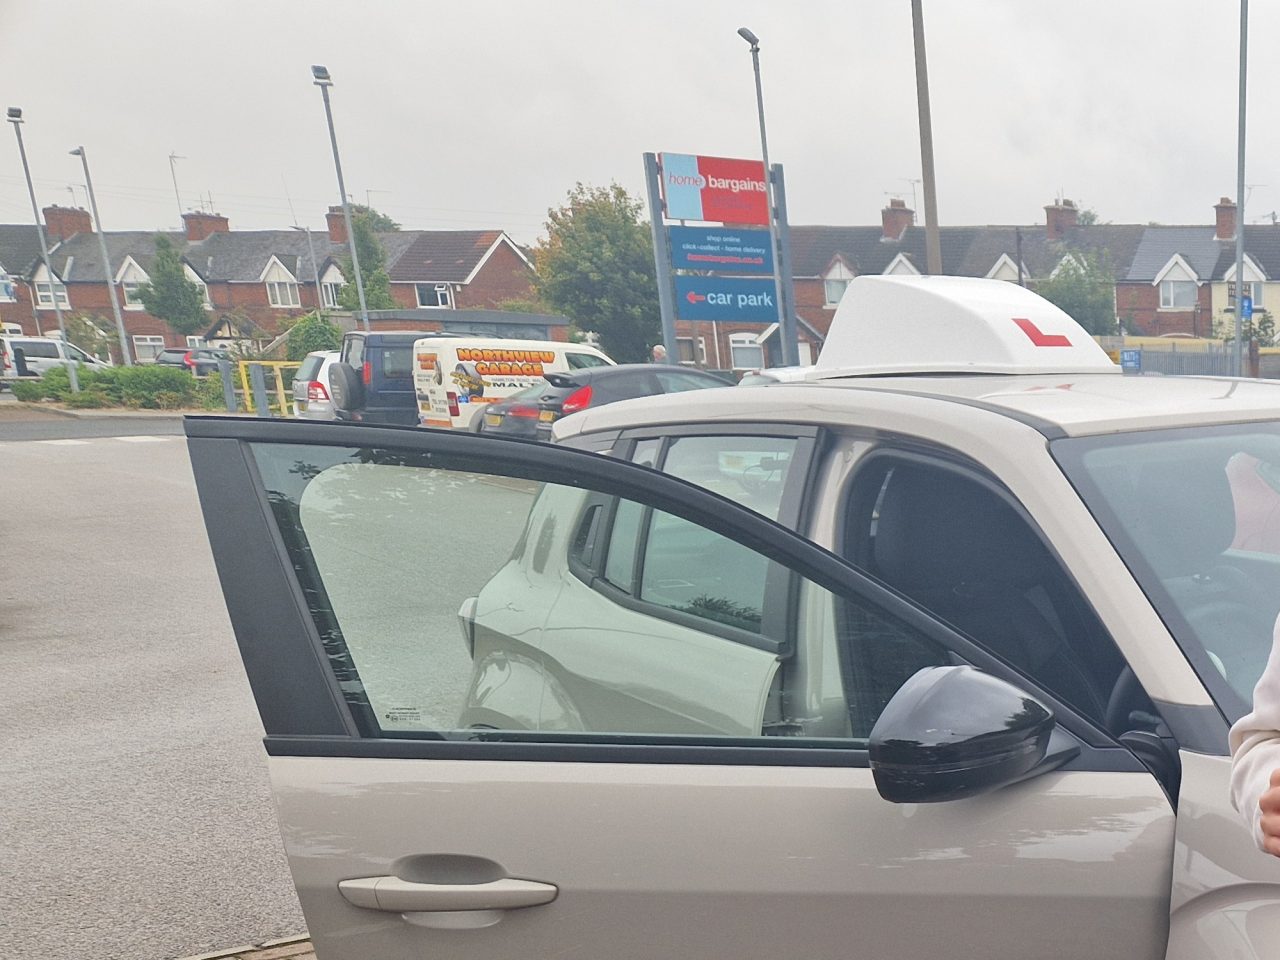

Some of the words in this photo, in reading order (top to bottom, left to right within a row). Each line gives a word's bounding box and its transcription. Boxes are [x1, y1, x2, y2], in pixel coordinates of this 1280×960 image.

[669, 171, 700, 187] home
[708, 174, 766, 192] bargains
[707, 292, 733, 305] car
[737, 291, 773, 308] park
[1011, 318, 1073, 347] L
[456, 348, 555, 363] NORTHVIEW
[475, 362, 544, 376] GARAGE
